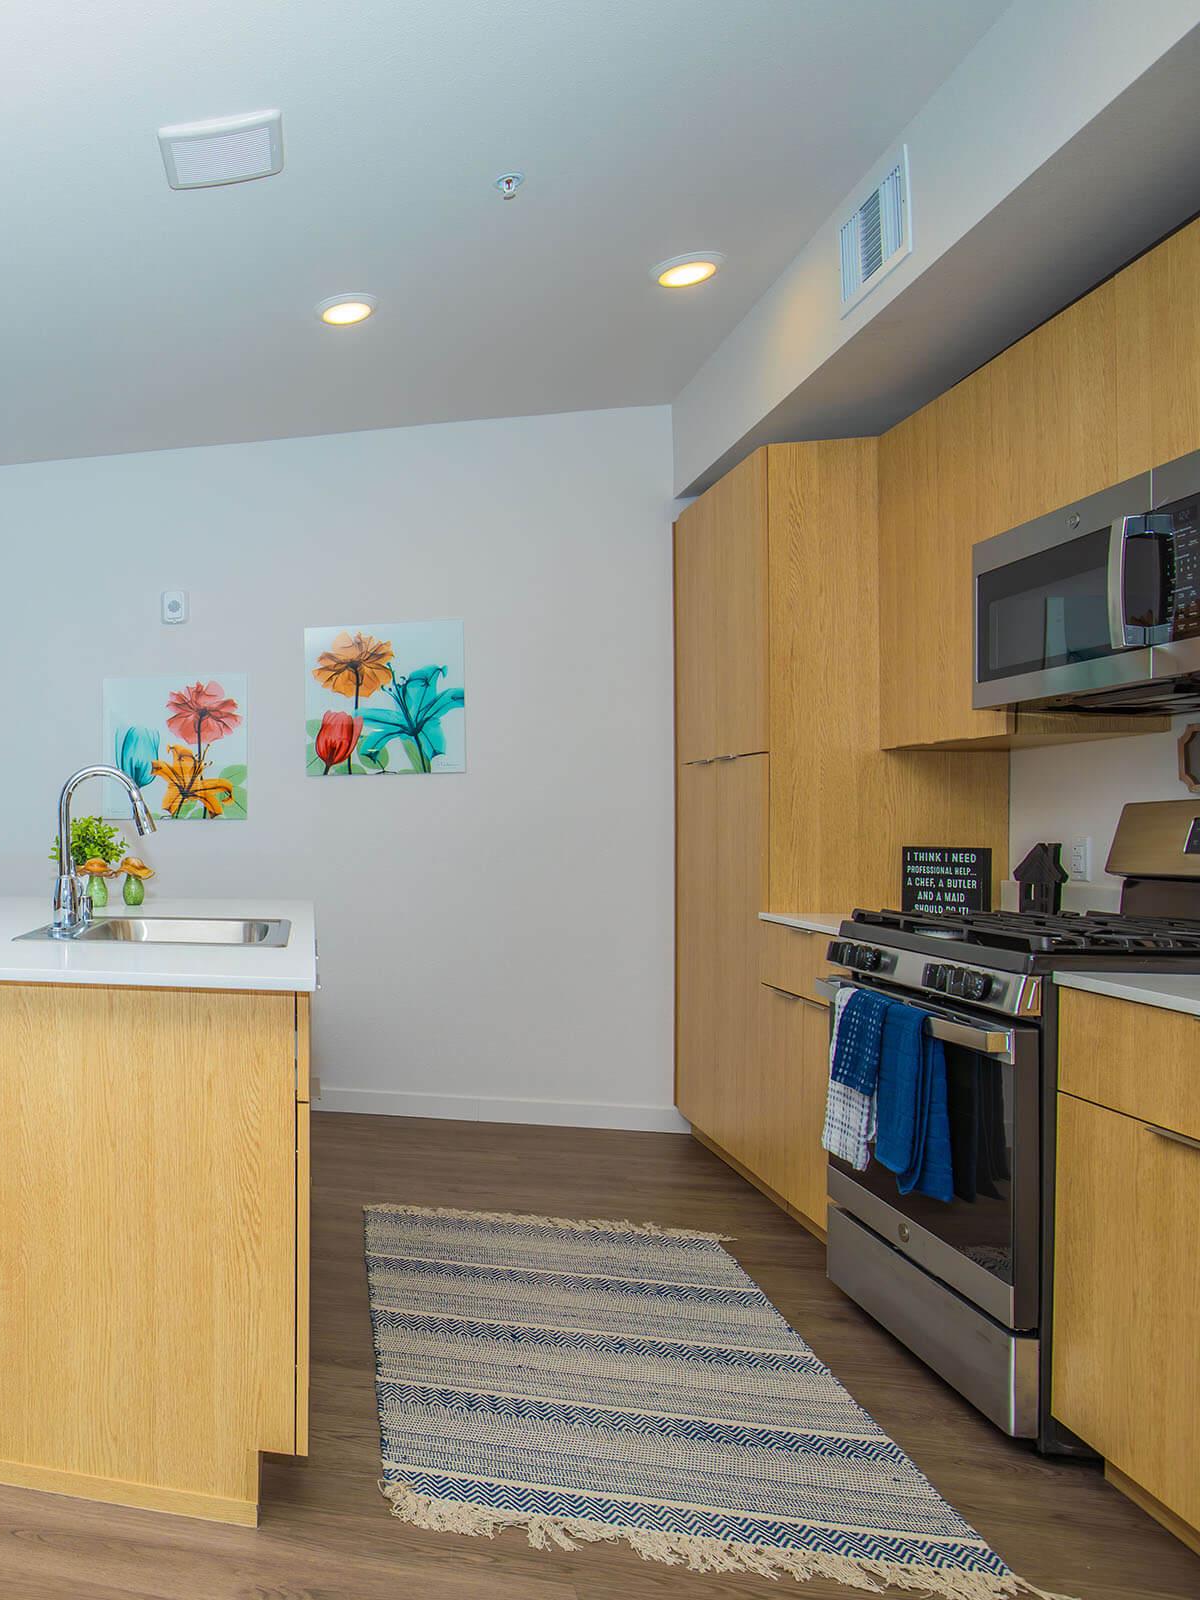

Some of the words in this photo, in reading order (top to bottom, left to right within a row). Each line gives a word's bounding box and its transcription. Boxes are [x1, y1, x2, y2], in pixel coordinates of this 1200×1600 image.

[914, 852, 942, 862] THINK
[951, 853, 977, 863] NEED
[906, 865, 953, 875] PROFESSIONAL
[907, 877, 912, 886] A
[915, 877, 936, 888] CHEF,
[938, 878, 944, 888] A
[947, 879, 977, 889] BUTLER
[917, 891, 934, 901] AND
[936, 891, 942, 901] A
[944, 892, 965, 902] MAID
[914, 904, 943, 914] SHOULD
